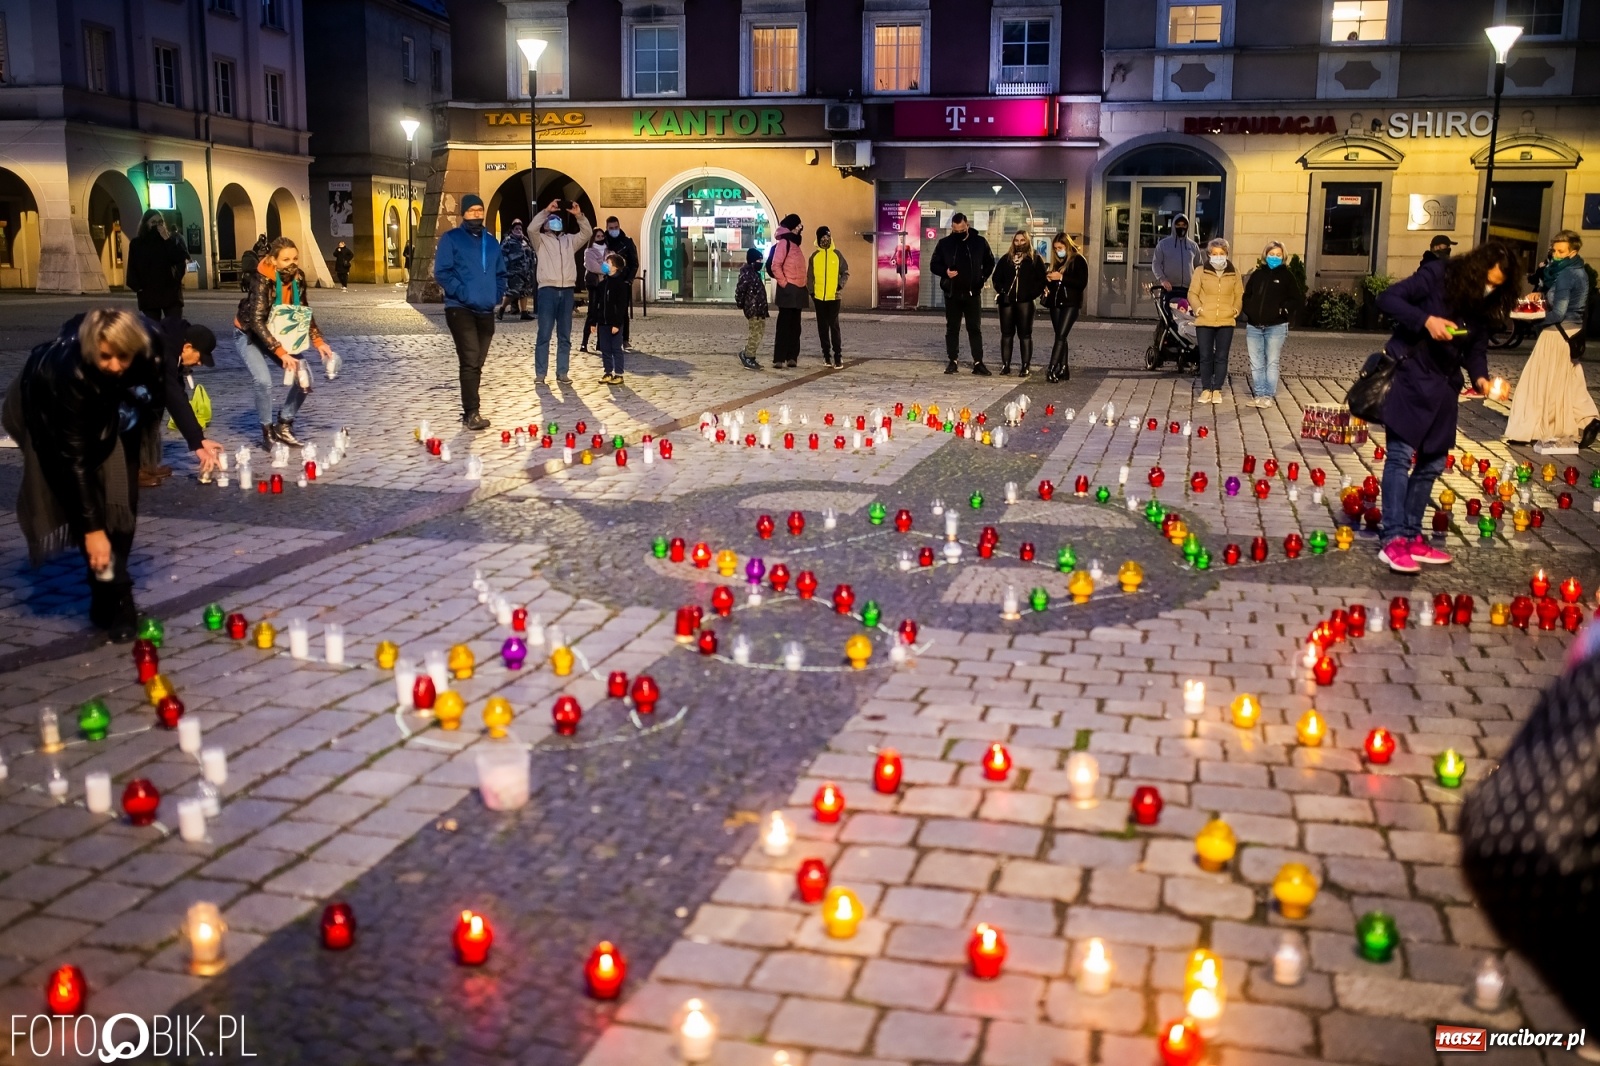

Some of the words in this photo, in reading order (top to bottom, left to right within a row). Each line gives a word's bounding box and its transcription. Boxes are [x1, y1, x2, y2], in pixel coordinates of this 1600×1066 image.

[484, 112, 585, 126] TABAC
[632, 109, 785, 136] KANTOR
[1184, 115, 1338, 134] RESTAURACJA
[1387, 110, 1493, 138] SHIRO
[390, 184, 419, 200] JUBILR
[688, 189, 742, 199] KANTOR
[664, 213, 675, 280] KANTOR
